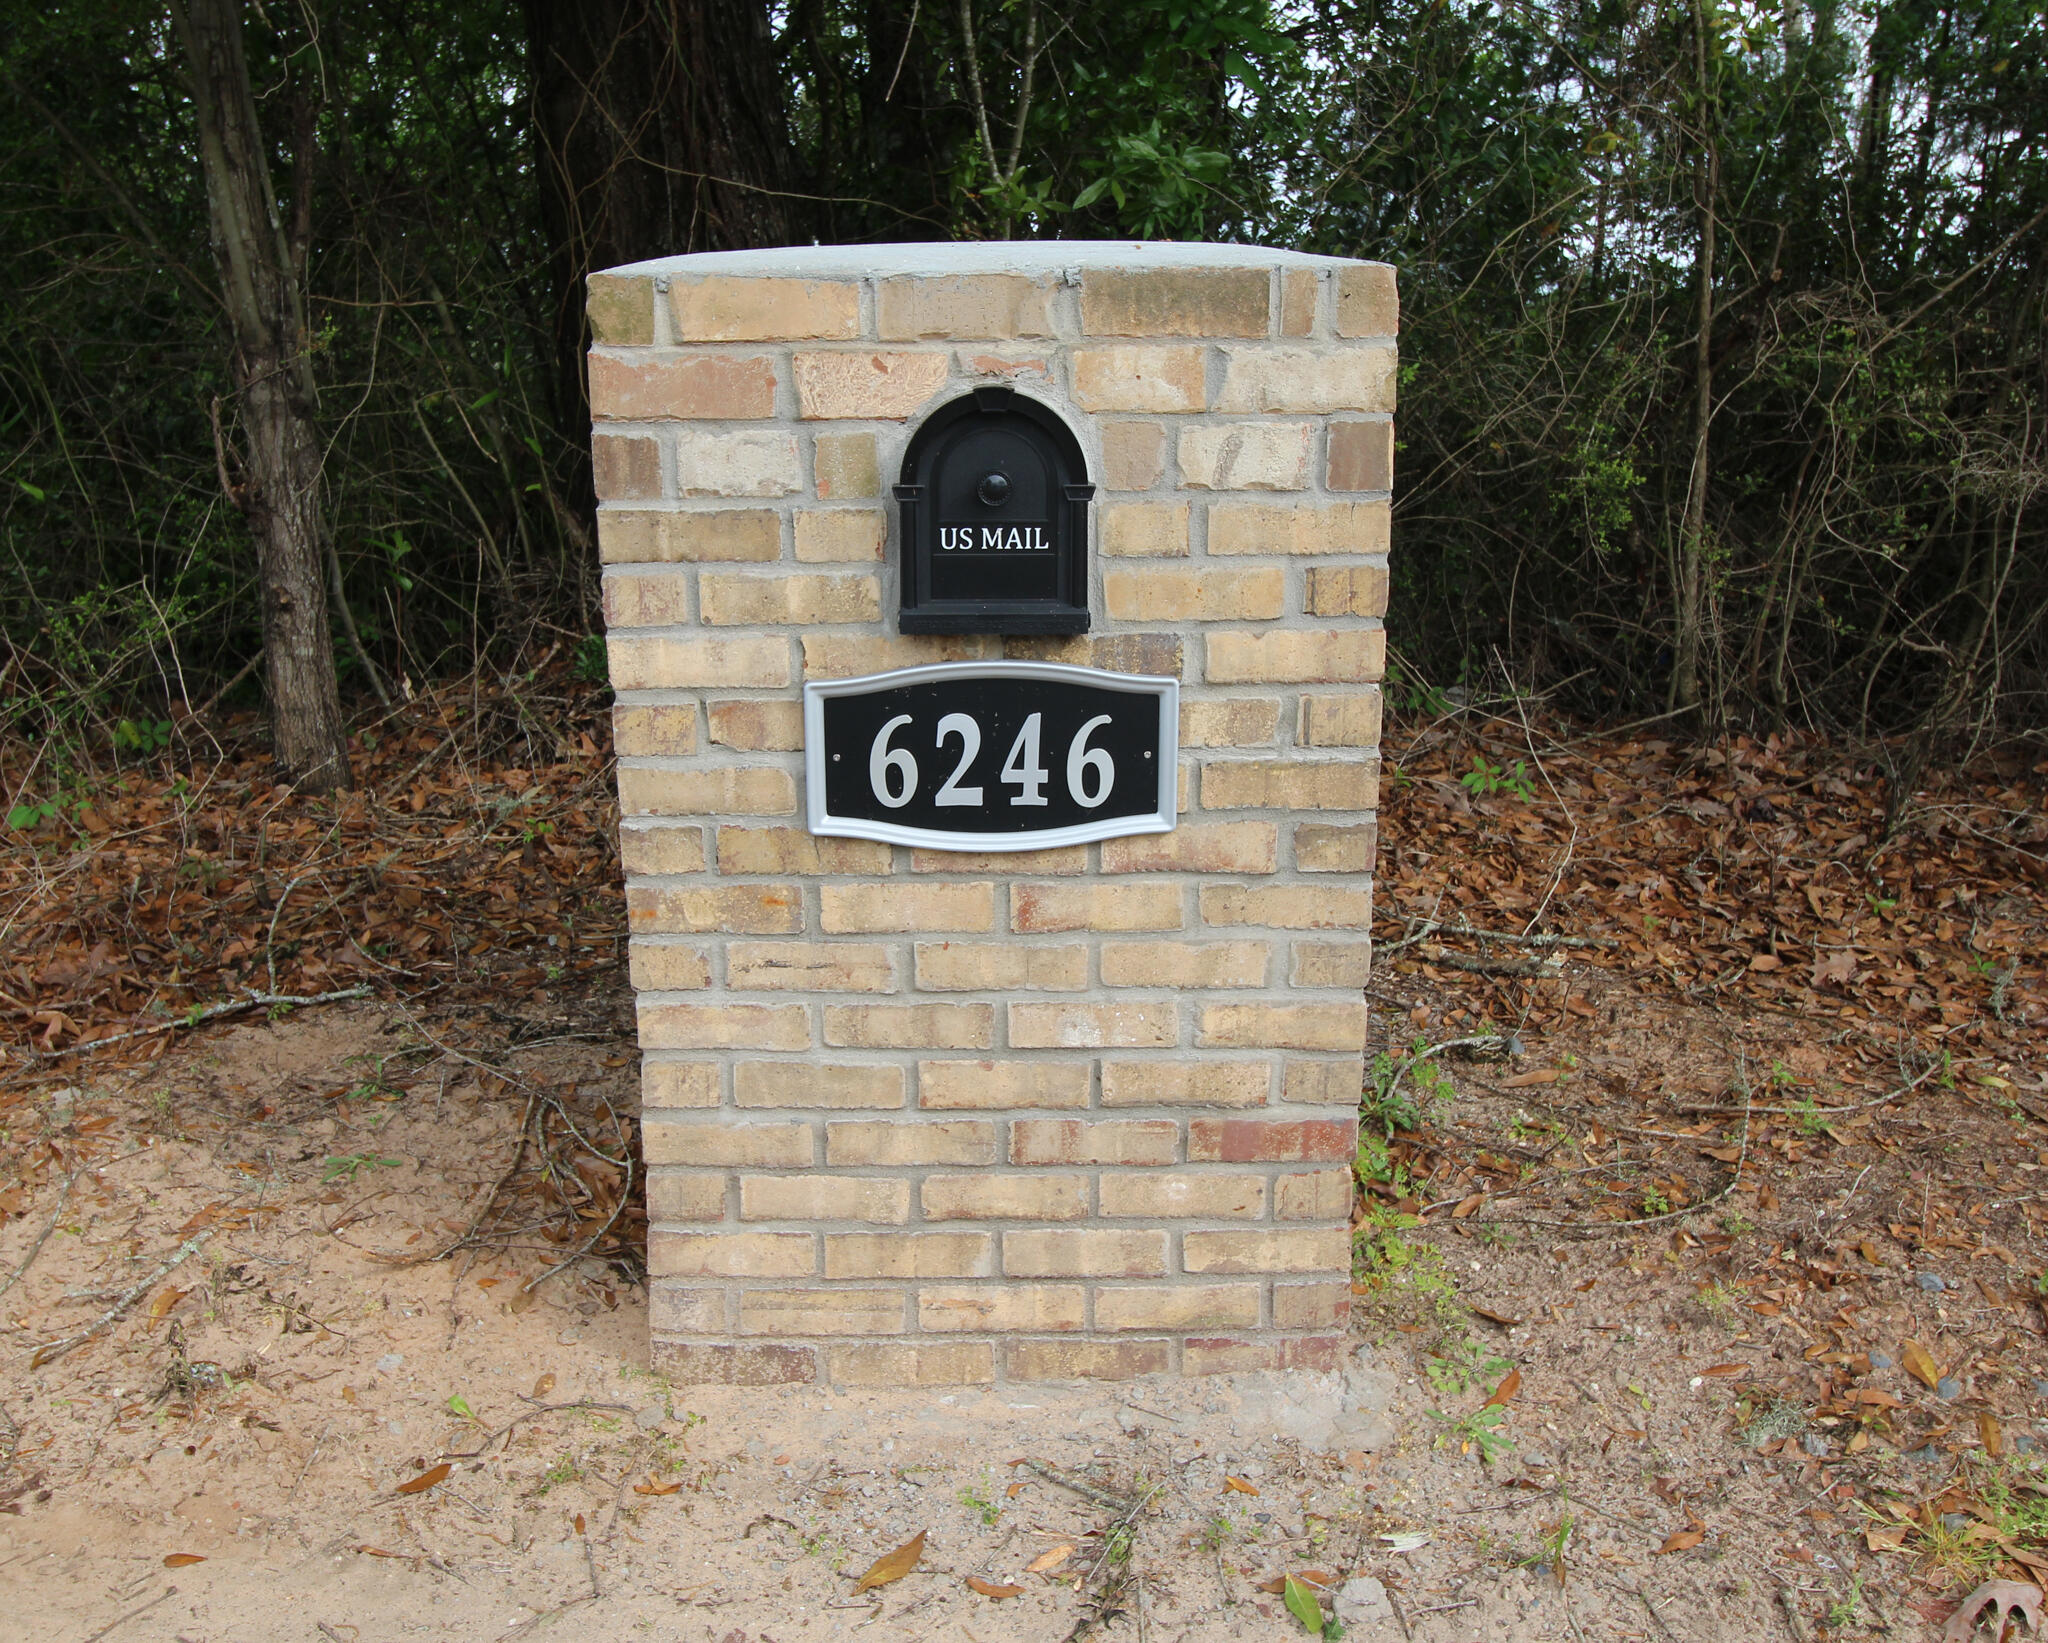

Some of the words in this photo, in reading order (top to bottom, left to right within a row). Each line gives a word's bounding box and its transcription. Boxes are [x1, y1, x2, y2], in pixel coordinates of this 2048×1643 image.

[939, 527, 973, 550] US
[981, 527, 1049, 550] MAIL
[869, 712, 1115, 808] 6246
